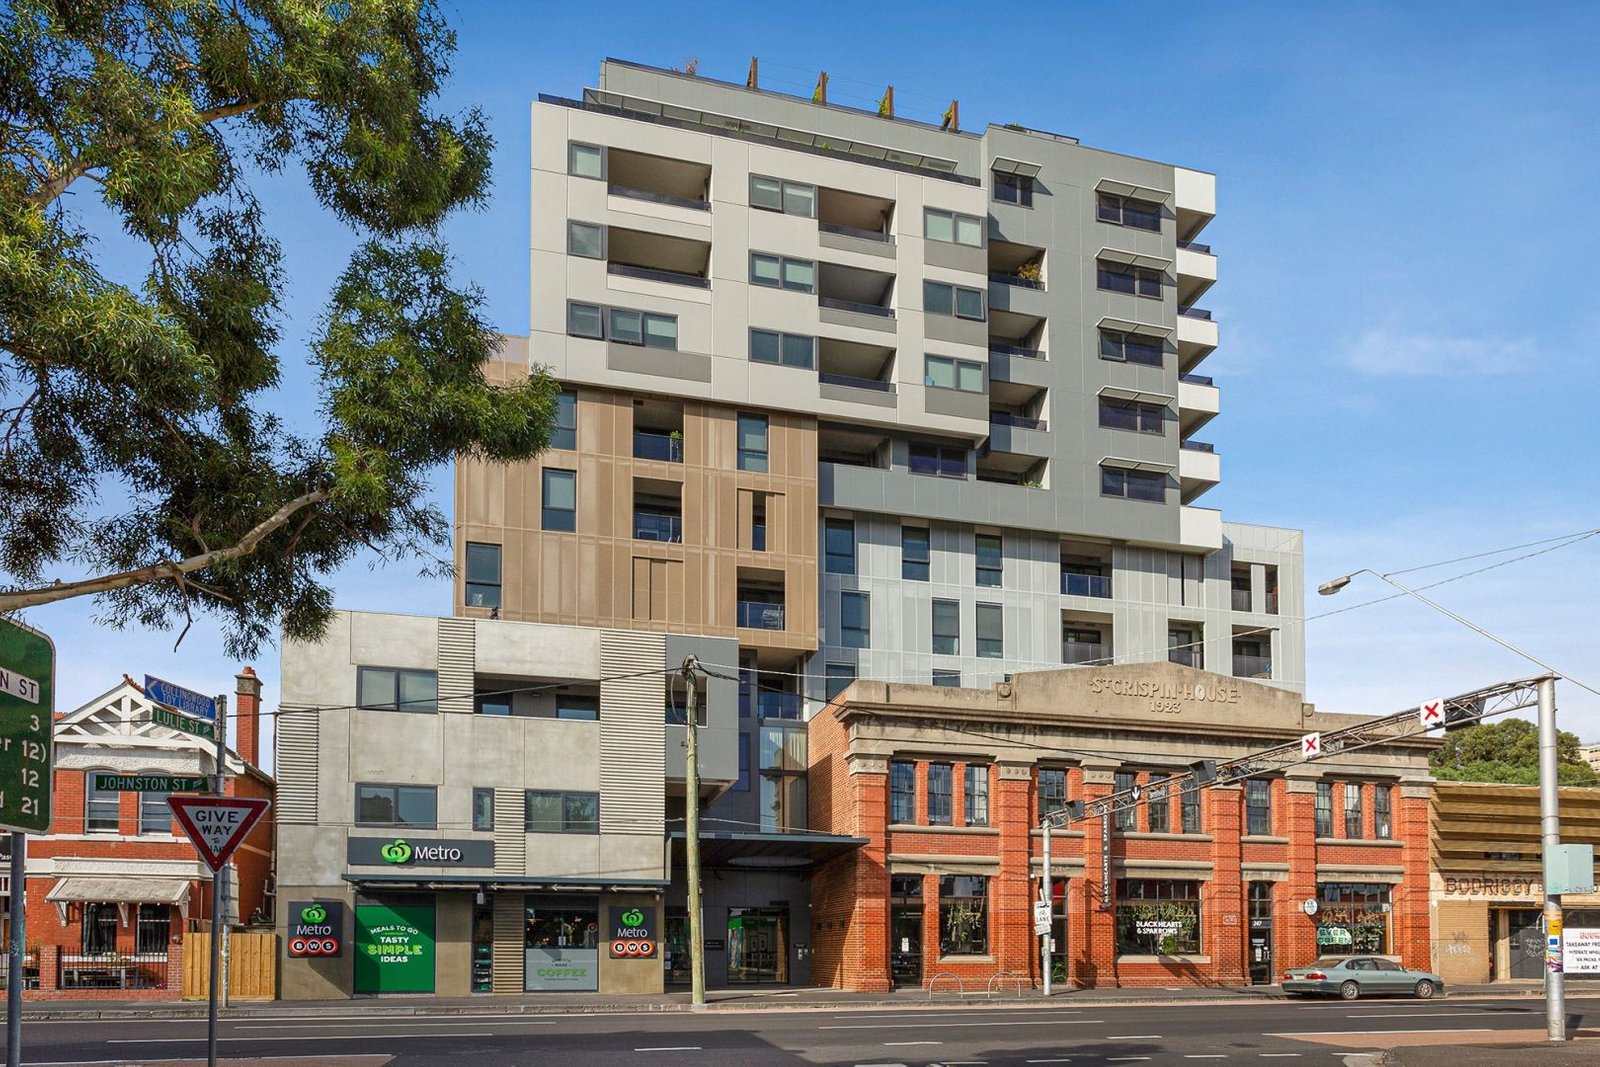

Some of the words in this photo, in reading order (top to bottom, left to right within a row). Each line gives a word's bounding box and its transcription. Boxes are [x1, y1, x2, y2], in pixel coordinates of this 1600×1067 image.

[18, 678, 37, 699] ST
[161, 683, 210, 707] COLLINGWOOD
[163, 694, 177, 705] TOY
[178, 698, 209, 717] LIBRARY
[1150, 701, 1182, 714] 1923
[30, 714, 40, 732] 3
[156, 709, 185, 730] LULIE
[188, 719, 200, 733] ST
[22, 739, 47, 763] 12)
[21, 768, 39, 788] 12
[100, 777, 168, 790] JOHNSTON
[172, 778, 187, 791] ST
[21, 796, 39, 816] 21
[195, 810, 239, 823] GIVE
[202, 825, 232, 835] WAY
[414, 846, 461, 861] Metro
[1445, 877, 1535, 896] BODRIGGY
[296, 925, 331, 935] Metro
[371, 925, 395, 934] MEALS
[407, 927, 418, 935] GO
[617, 928, 648, 938] Metro
[367, 944, 423, 955] SIMPLE
[536, 968, 588, 977] COFFEE
